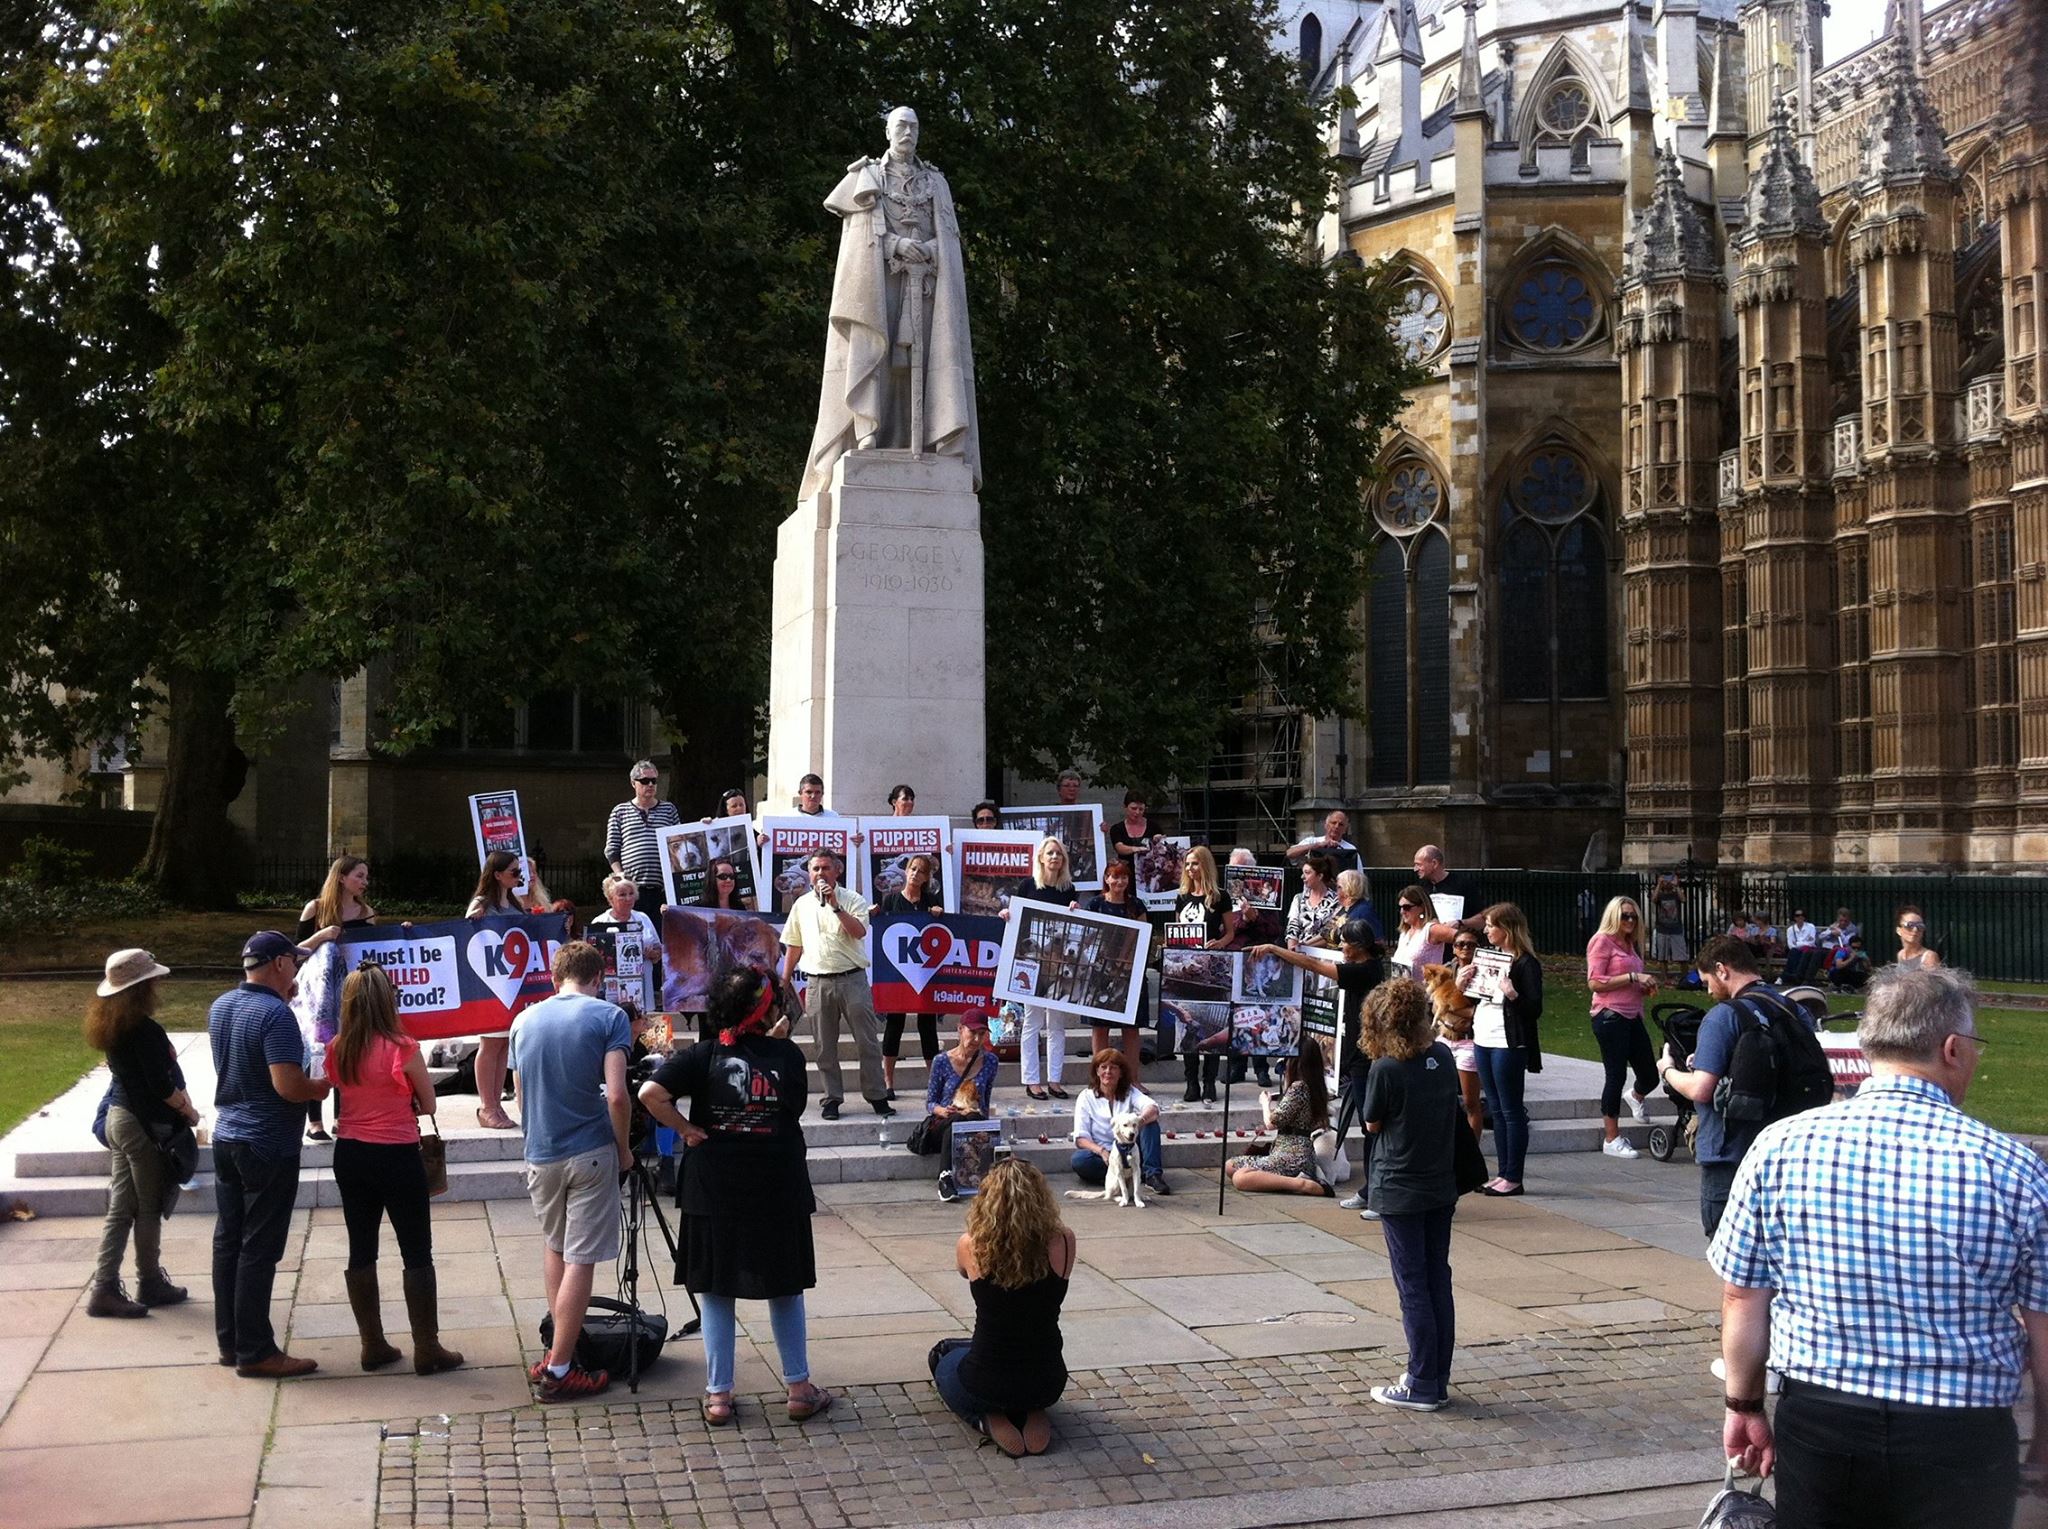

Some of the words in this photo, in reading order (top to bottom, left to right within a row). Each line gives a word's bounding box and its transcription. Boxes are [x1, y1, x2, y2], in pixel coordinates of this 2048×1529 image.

[851, 542, 943, 563] GEORGE
[951, 546, 963, 564] V
[862, 573, 953, 593] 1910-1936
[776, 830, 843, 848] PUPPIES
[873, 830, 937, 847] PUPPIES
[965, 852, 1029, 867] HUMANE
[1167, 927, 1203, 939] FRIEND
[362, 947, 405, 966] Must
[410, 946, 415, 964] I
[420, 945, 442, 962] be
[388, 967, 431, 986] ILLED
[933, 990, 986, 1007] k9aid.org
[1829, 1059, 1871, 1074] MAN
